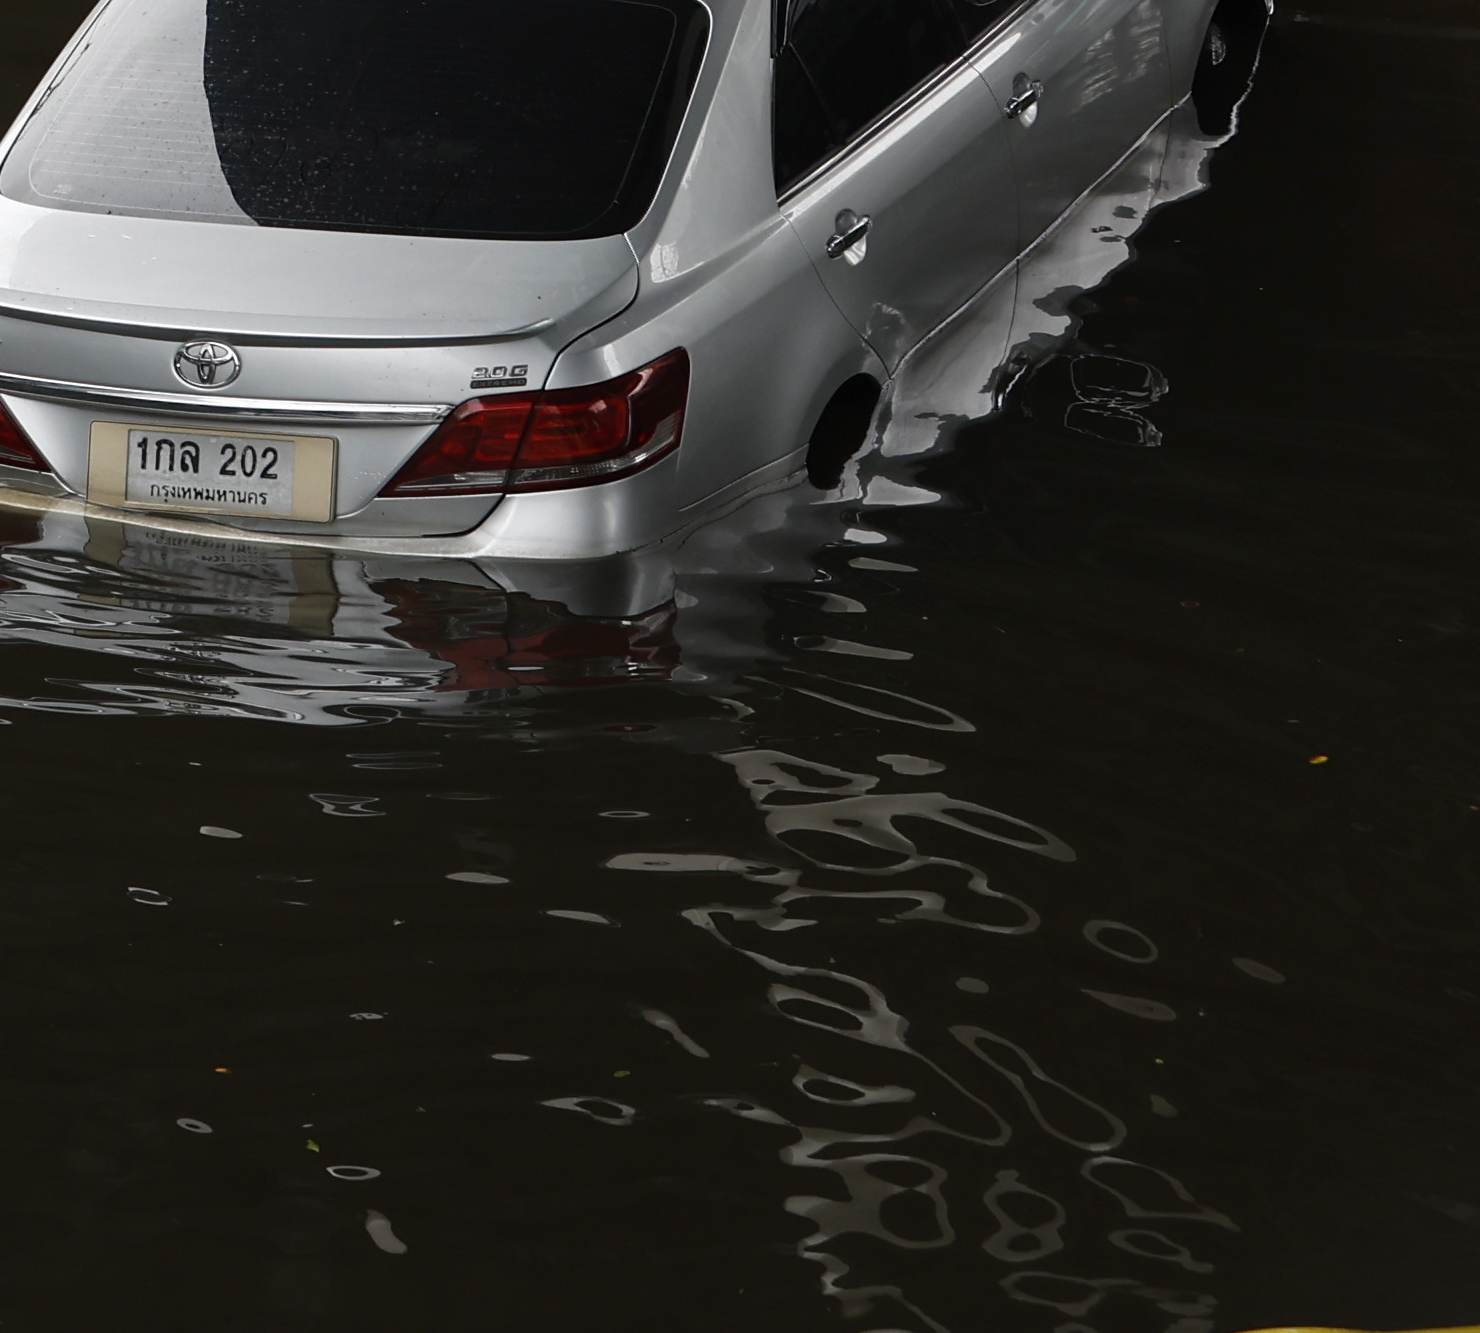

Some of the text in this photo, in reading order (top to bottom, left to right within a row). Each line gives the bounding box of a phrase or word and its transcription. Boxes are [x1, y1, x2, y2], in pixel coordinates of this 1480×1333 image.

[472, 378, 526, 389] EXTREMO
[137, 436, 279, 480] 1กล 202
[150, 483, 269, 507] กรุงเทพมหานคร
